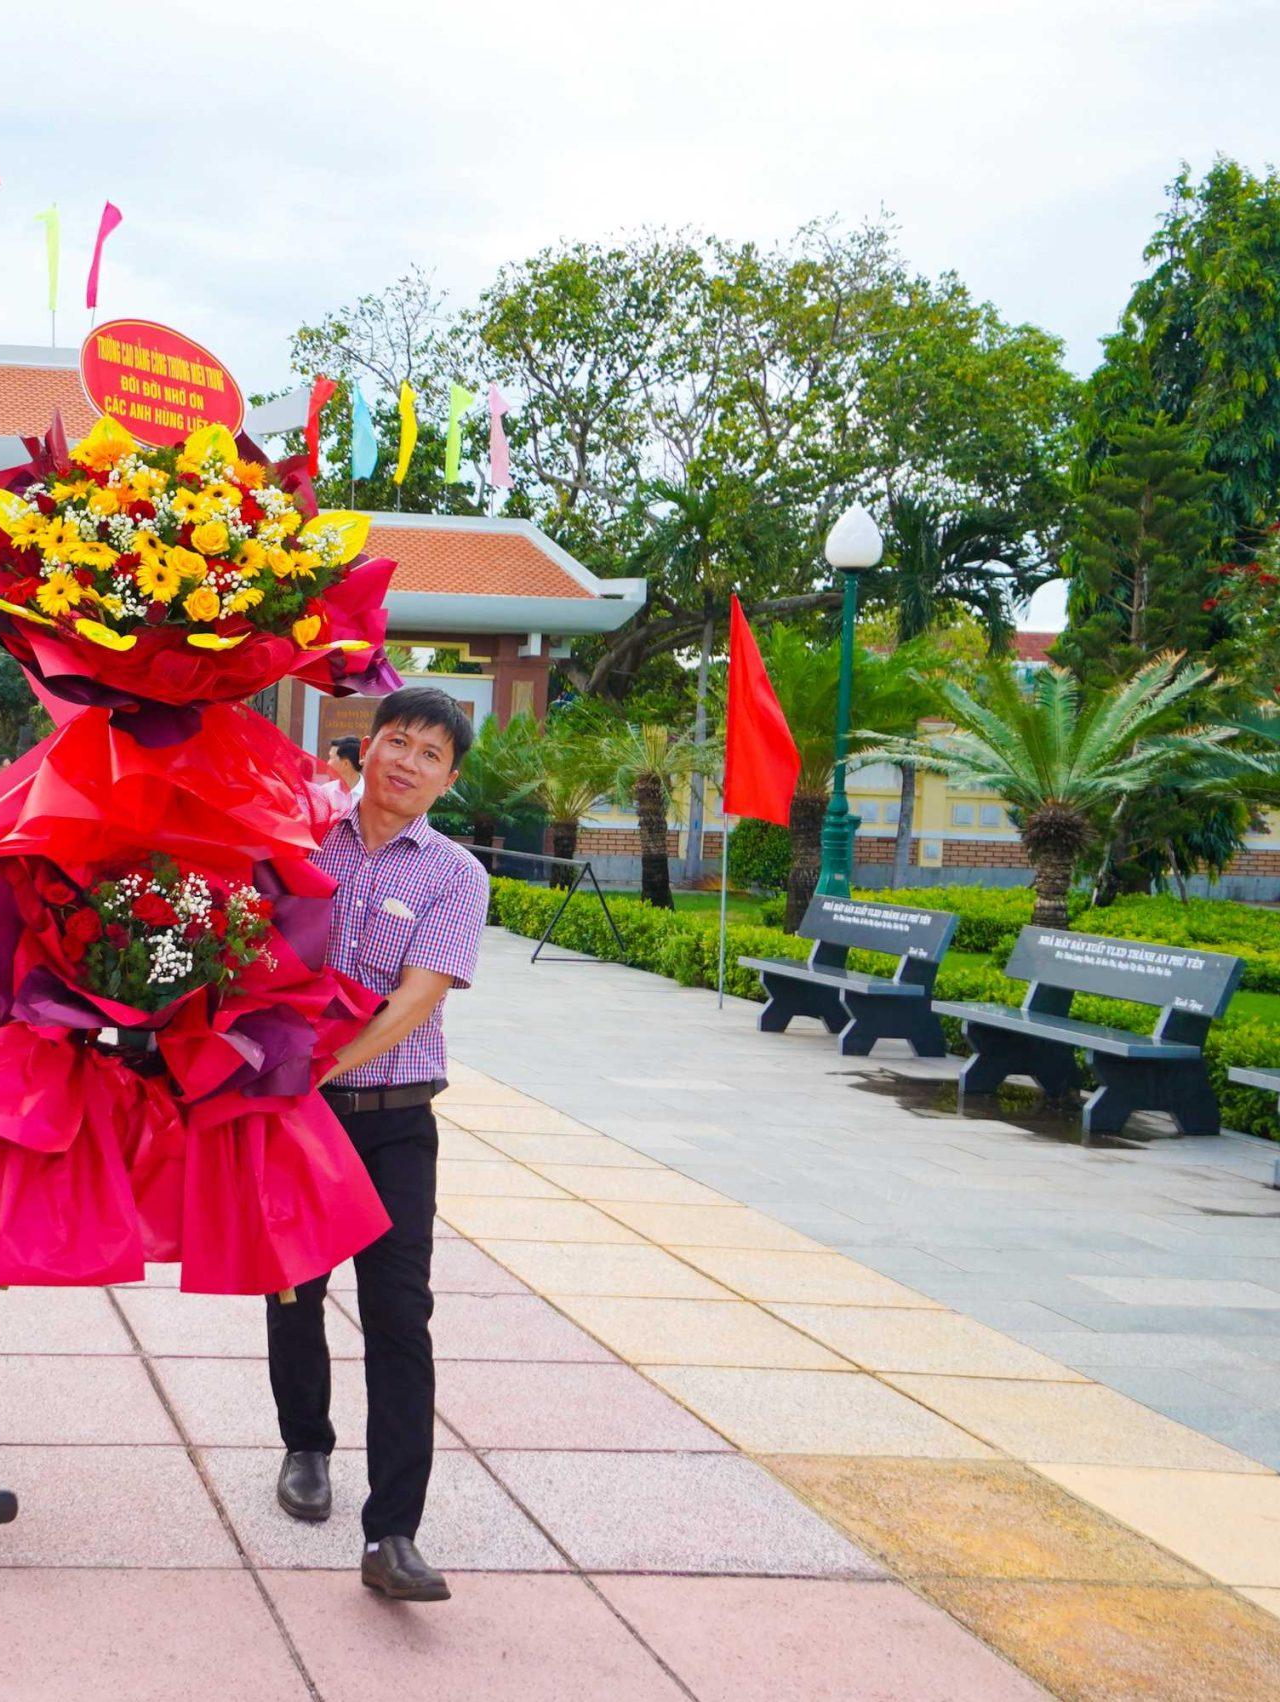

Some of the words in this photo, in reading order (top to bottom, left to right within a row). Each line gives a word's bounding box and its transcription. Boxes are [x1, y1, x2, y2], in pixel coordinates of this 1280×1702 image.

[120, 373, 139, 395] ĐỜI
[142, 379, 161, 401] ĐỜI
[164, 386, 186, 406] NHỚ
[189, 391, 205, 411] ƠN
[104, 394, 127, 416] CÁC
[129, 401, 152, 422] ANH
[154, 406, 185, 431] HÙNG
